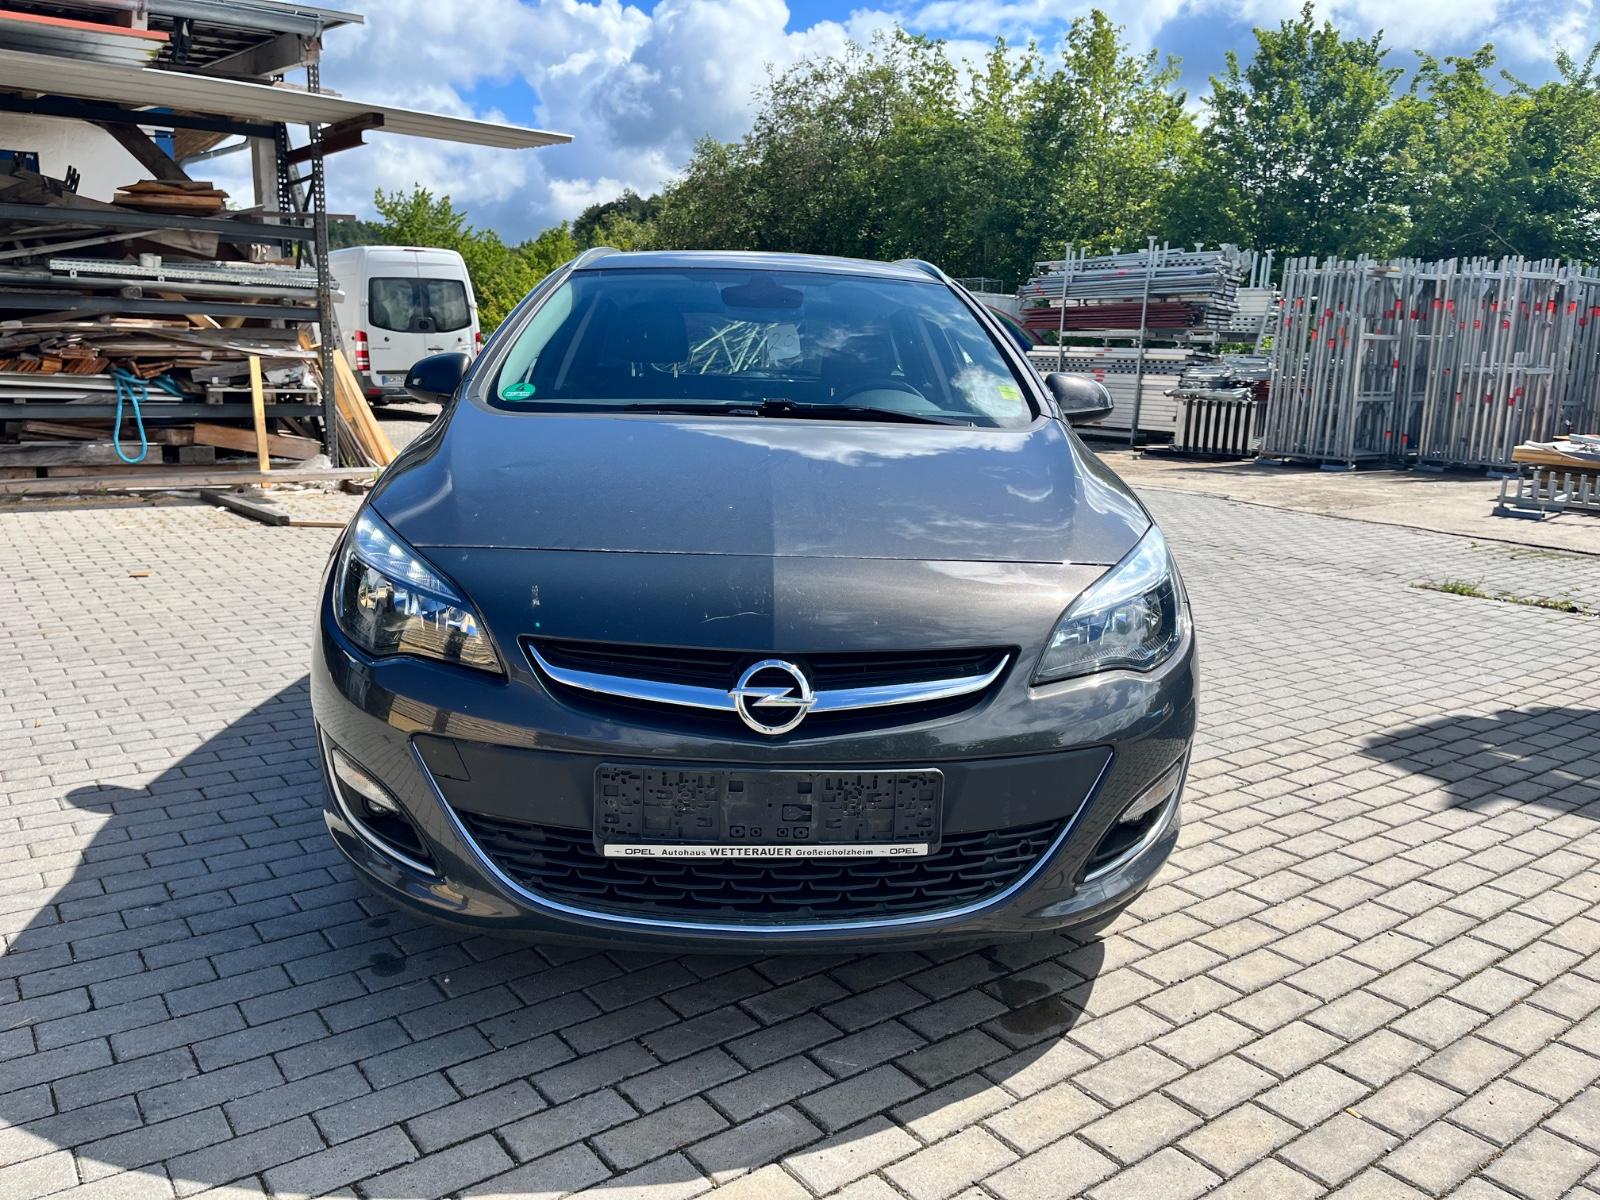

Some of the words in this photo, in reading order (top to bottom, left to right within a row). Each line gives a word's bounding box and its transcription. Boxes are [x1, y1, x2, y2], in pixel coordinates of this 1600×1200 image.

[661, 848, 706, 856] Autohaus
[710, 847, 792, 856] WETTERAUER
[795, 848, 874, 856] Großeicholzheim
